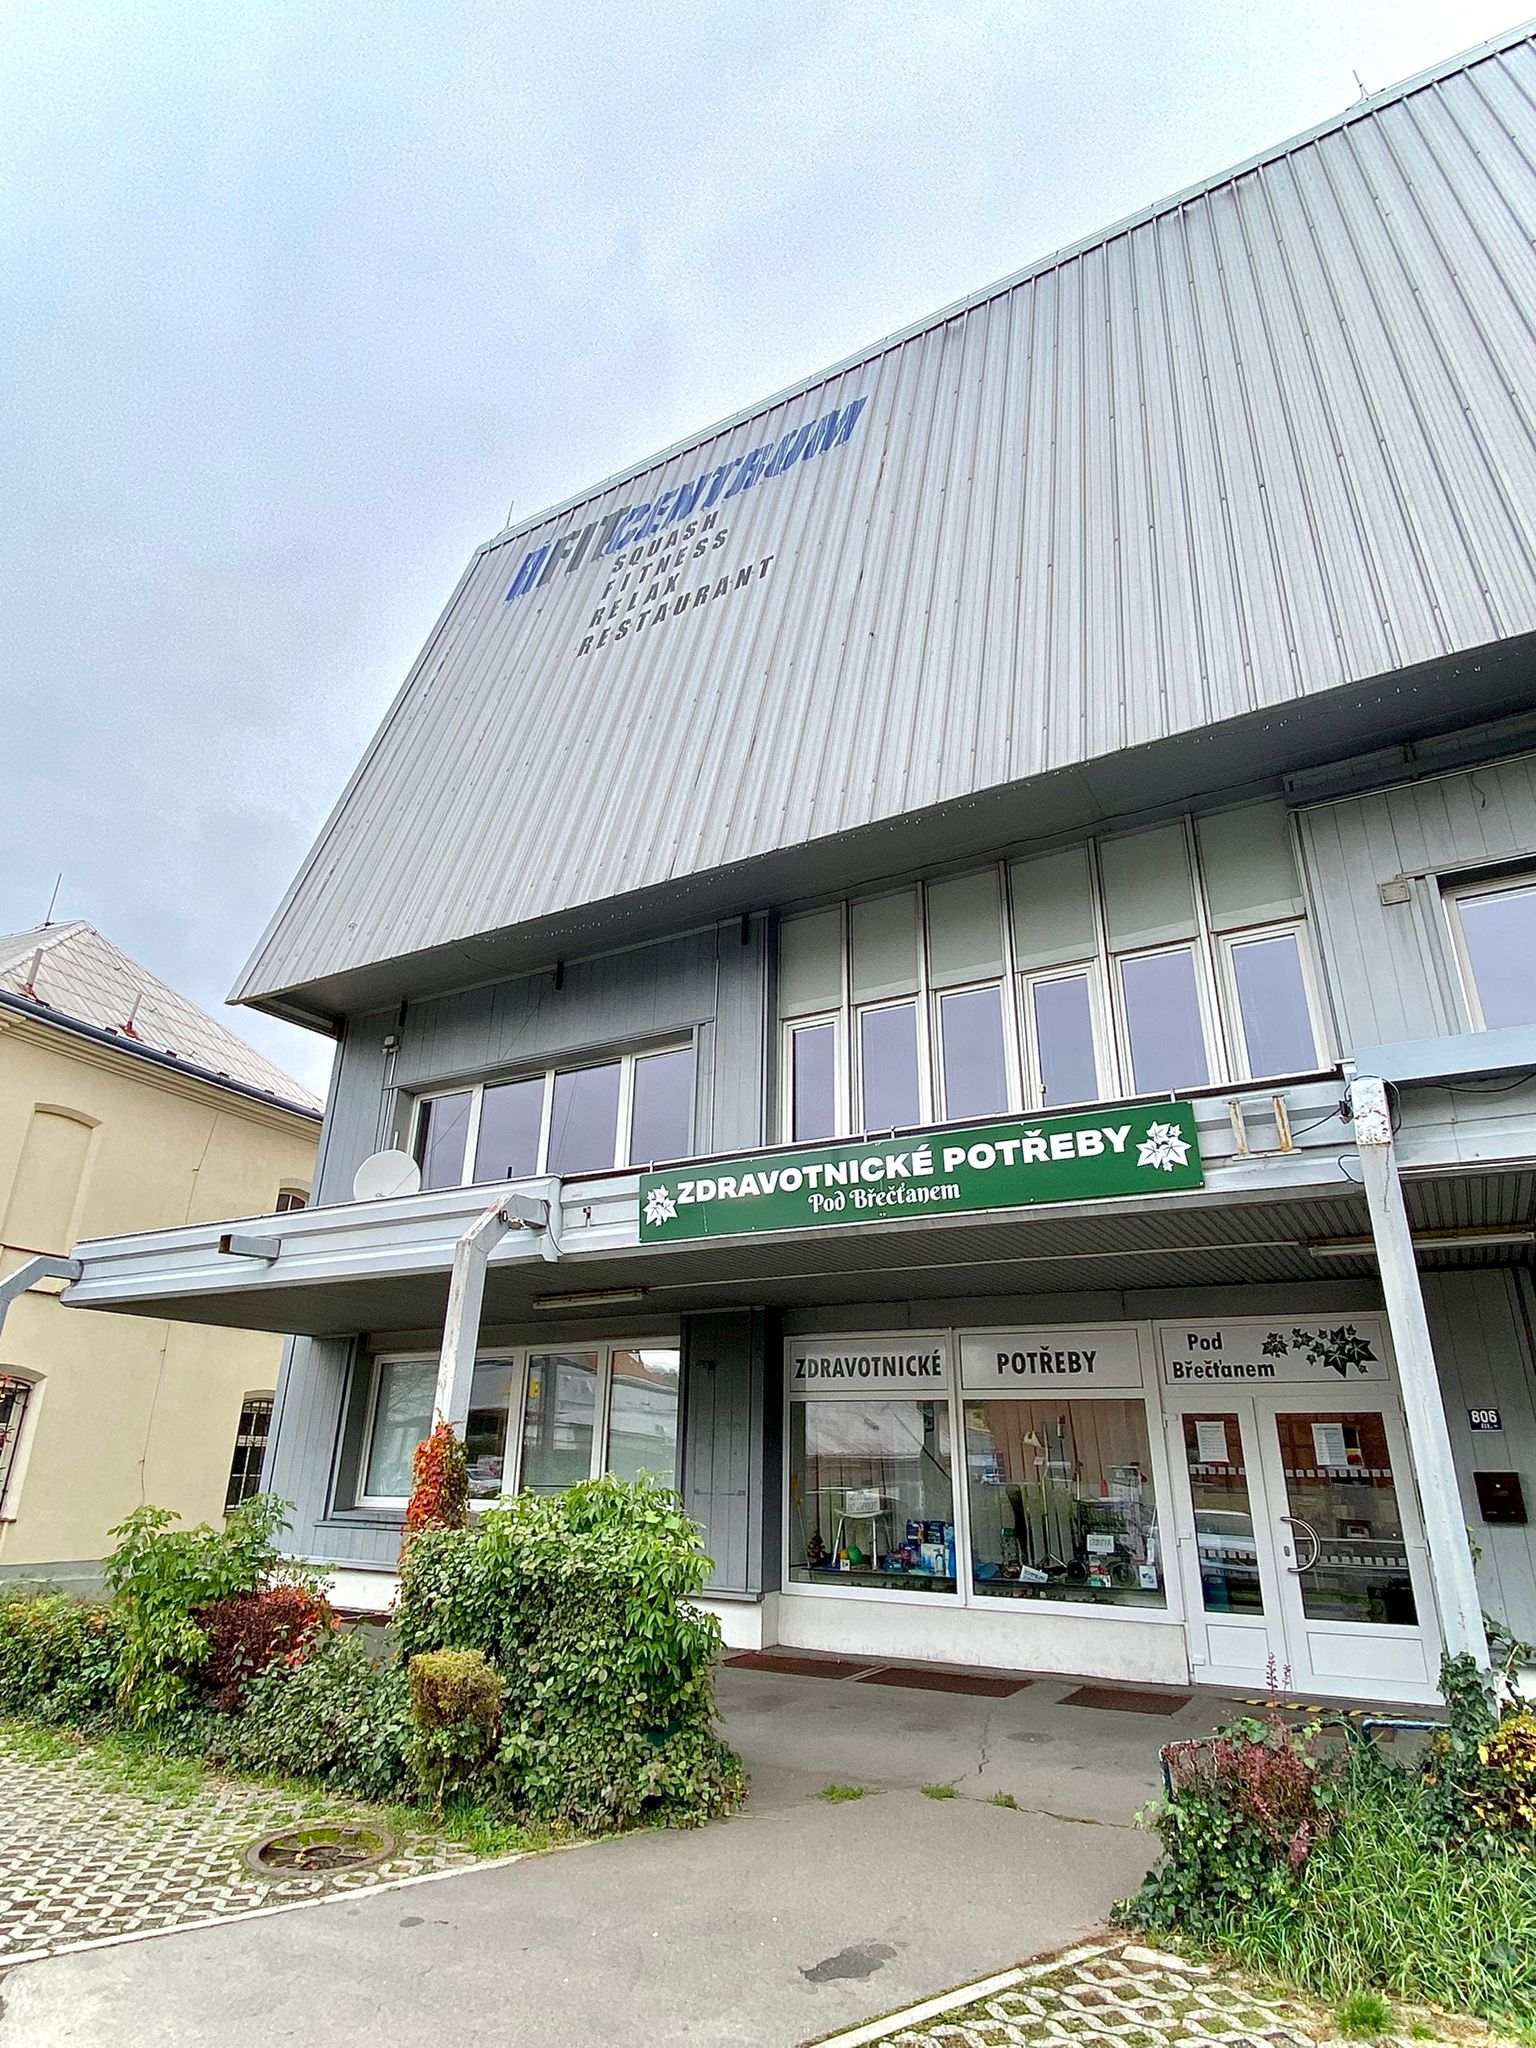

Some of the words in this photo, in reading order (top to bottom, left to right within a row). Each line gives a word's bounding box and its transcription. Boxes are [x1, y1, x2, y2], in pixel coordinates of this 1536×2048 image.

[601, 528, 728, 600] FITNESS
[611, 510, 719, 573] SQUASH
[576, 555, 774, 658] RESTAURANT
[588, 572, 680, 629] RELAX
[676, 1144, 934, 1205] ZDRAVOTNICKÉ
[944, 1124, 1133, 1173] POTŘEBY
[808, 1190, 846, 1214] Pod
[849, 1182, 961, 1209] Břečťanem
[795, 1349, 942, 1379] ZDRAVOTNICKÉ
[996, 1345, 1097, 1375] POTŘEBY
[1187, 1332, 1223, 1351] Pod
[1172, 1359, 1276, 1379] Břečťanem
[1471, 1410, 1497, 1423] 806
